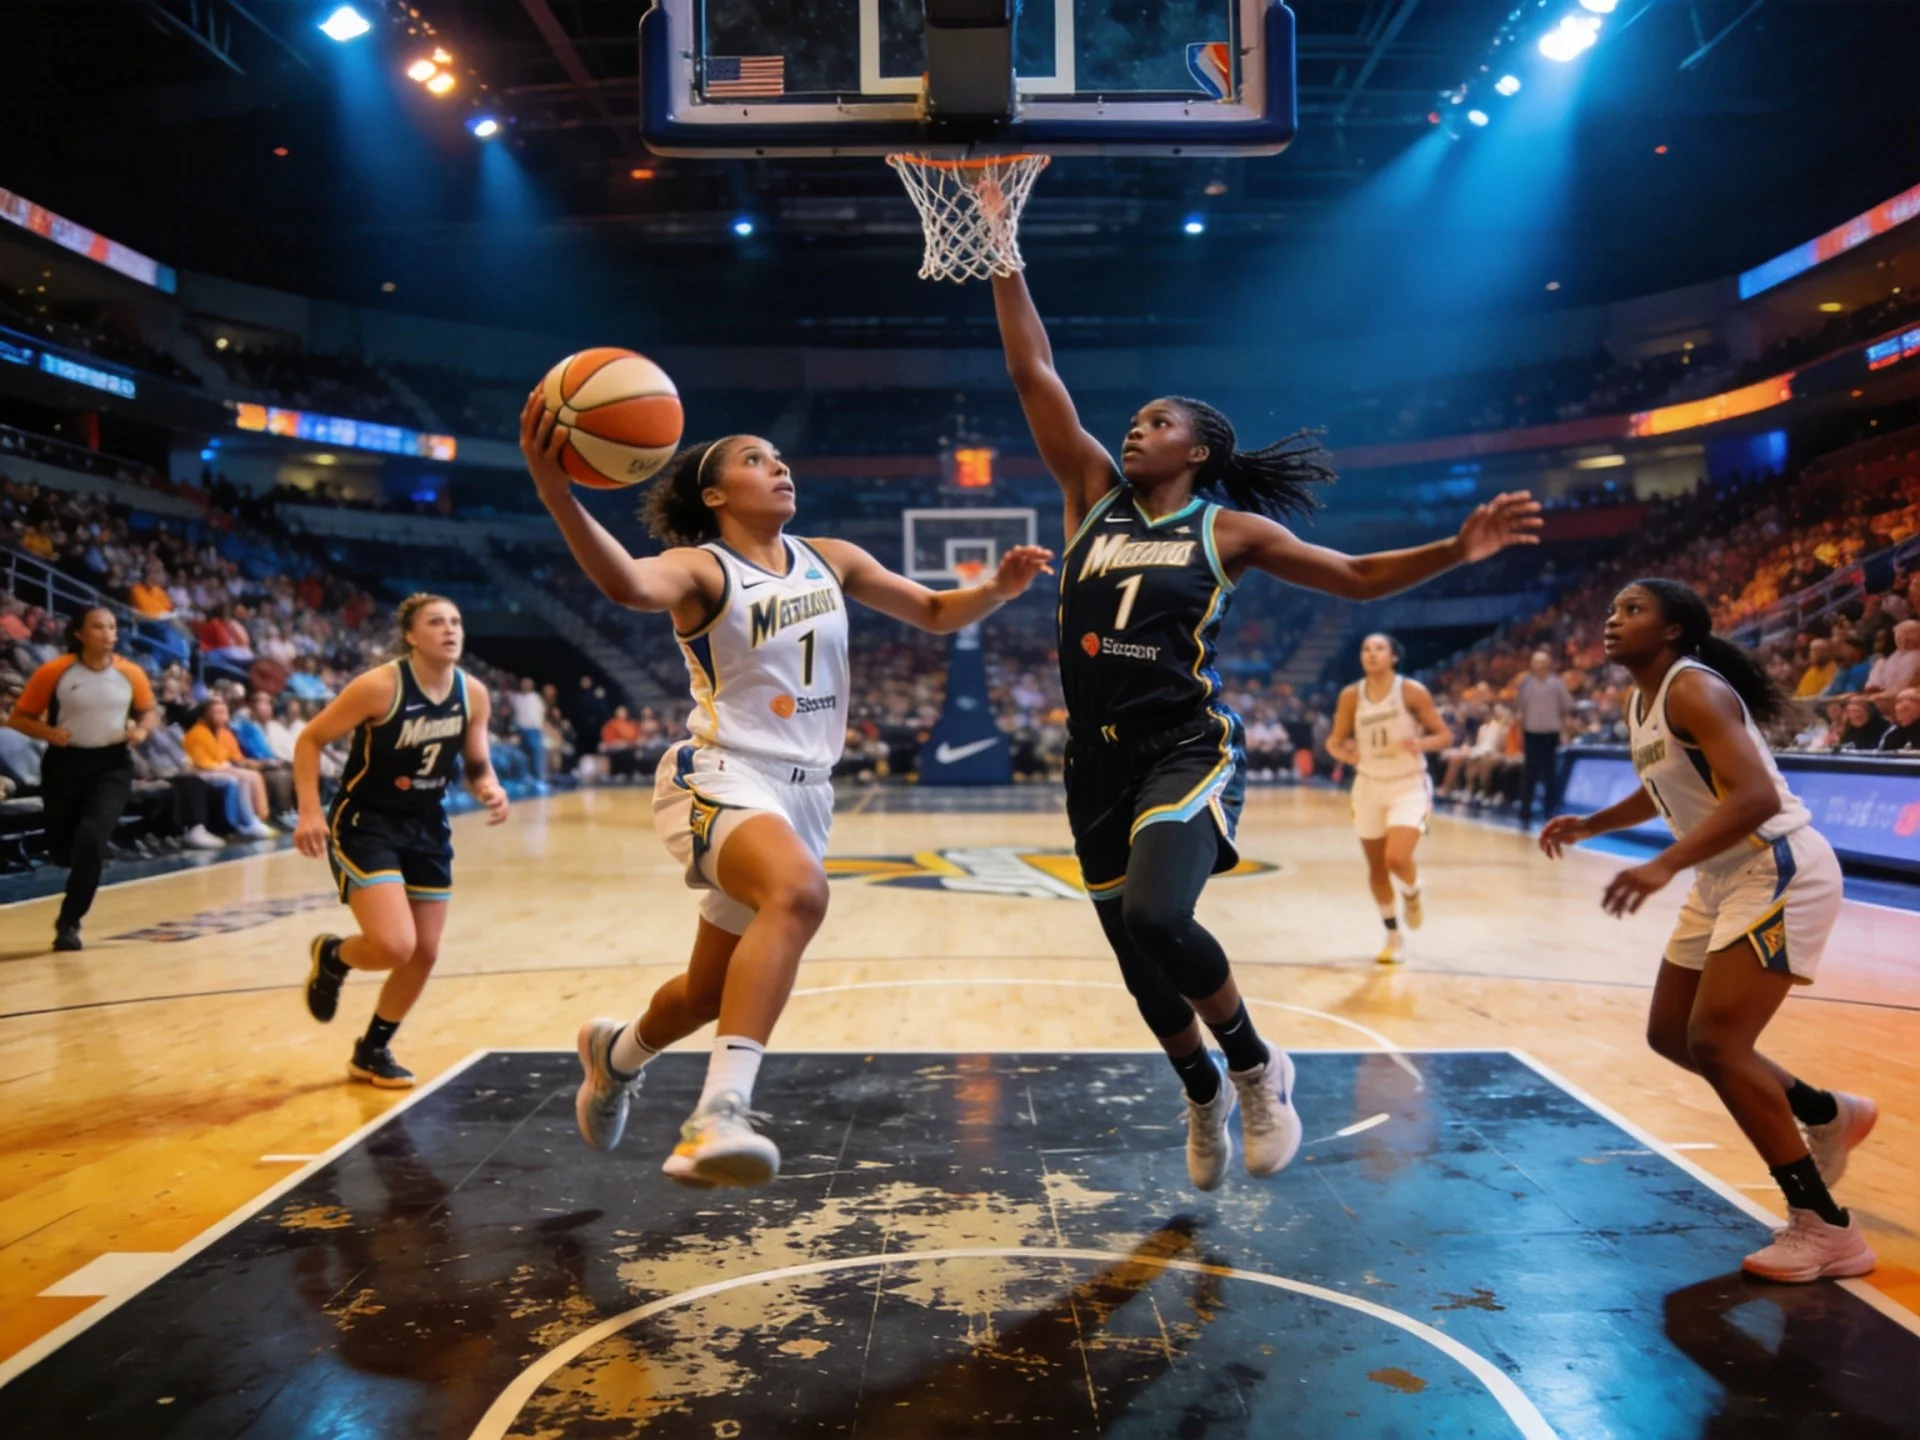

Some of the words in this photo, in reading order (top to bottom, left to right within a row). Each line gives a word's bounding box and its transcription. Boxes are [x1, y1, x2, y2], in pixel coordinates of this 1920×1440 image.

[1115, 574, 1143, 630] 1
[798, 628, 815, 687] 1
[416, 742, 442, 776] 3
